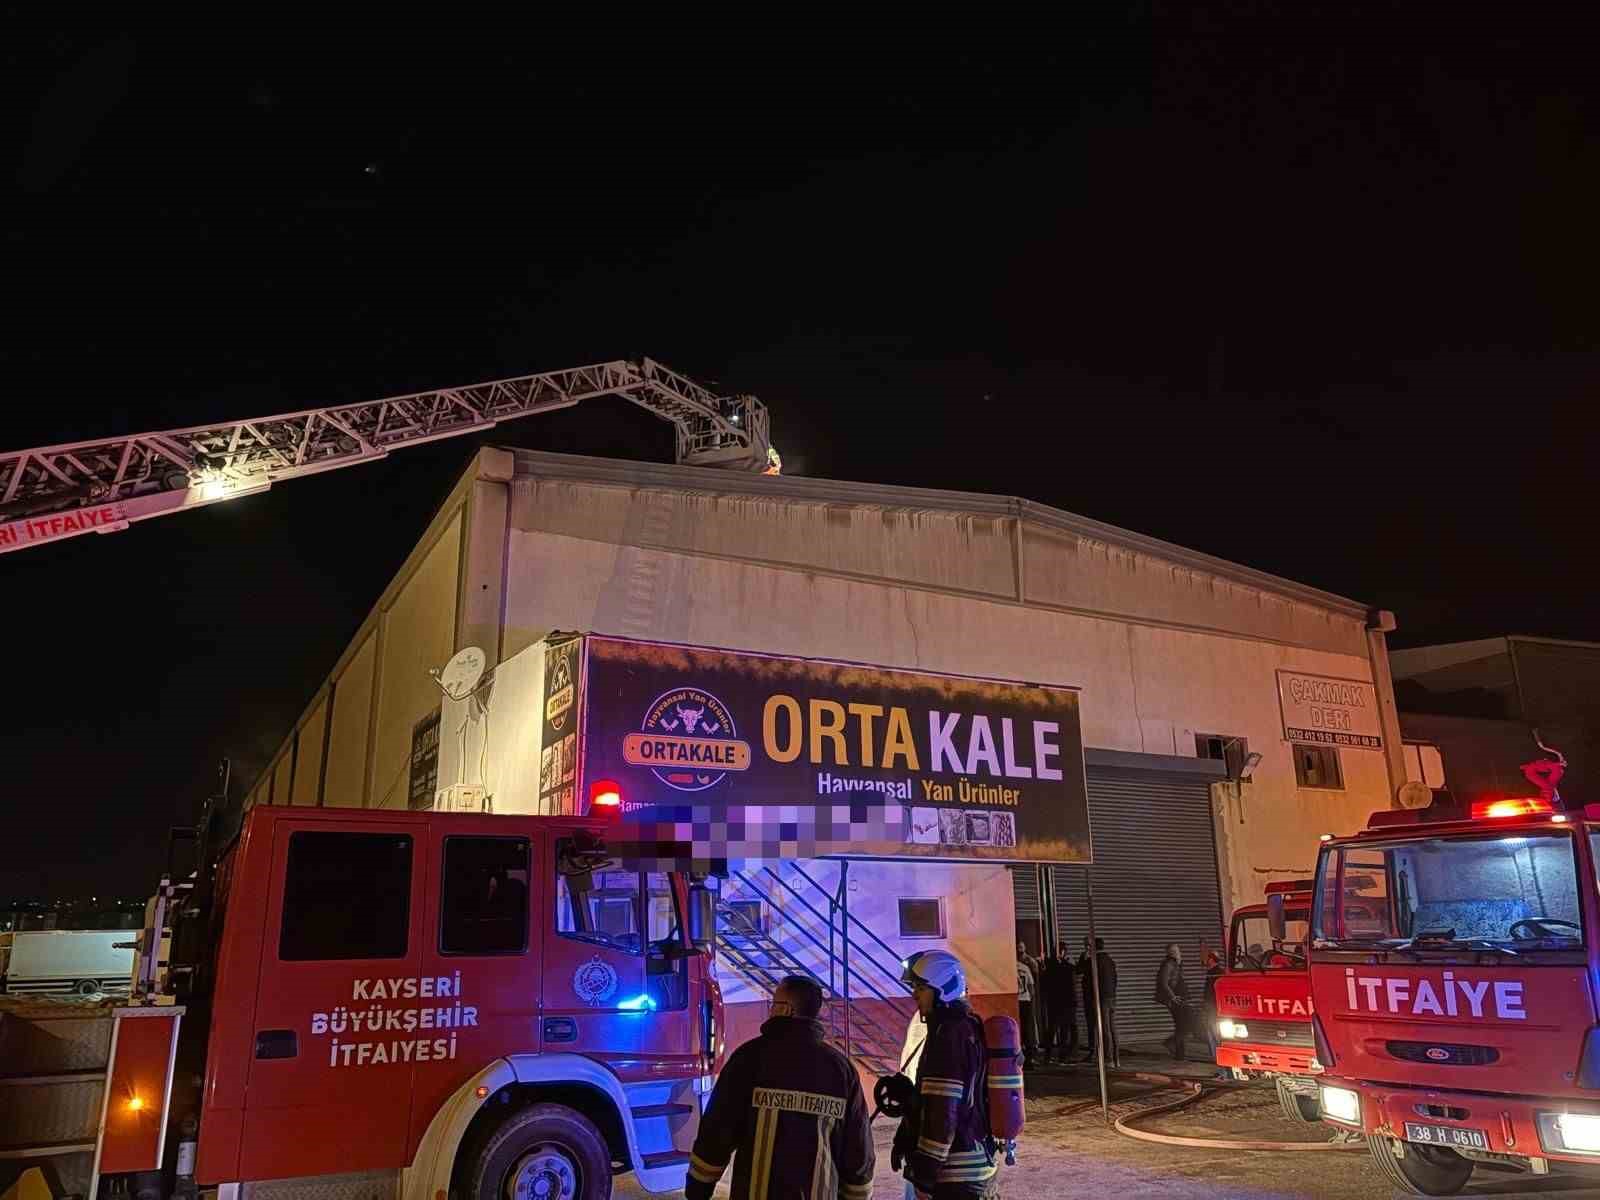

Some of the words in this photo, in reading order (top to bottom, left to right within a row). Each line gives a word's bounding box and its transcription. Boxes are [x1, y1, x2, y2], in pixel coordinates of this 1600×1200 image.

[647, 692, 686, 728] Hayvansal
[688, 692, 706, 704] Yan
[640, 740, 736, 764] ORTAKALE
[762, 695, 920, 770] ORTA
[928, 710, 1064, 781] KALE
[921, 779, 953, 801] Yan
[959, 777, 1020, 806] Ürünler
[352, 970, 461, 1000] KAYSERİ
[1345, 968, 1527, 1019] İTFAİYE
[311, 1001, 480, 1034] BÜYÜKŞEHİR
[1415, 1126, 1431, 1140] 38
[1437, 1128, 1446, 1142] H
[1453, 1130, 1481, 1146] 0610
